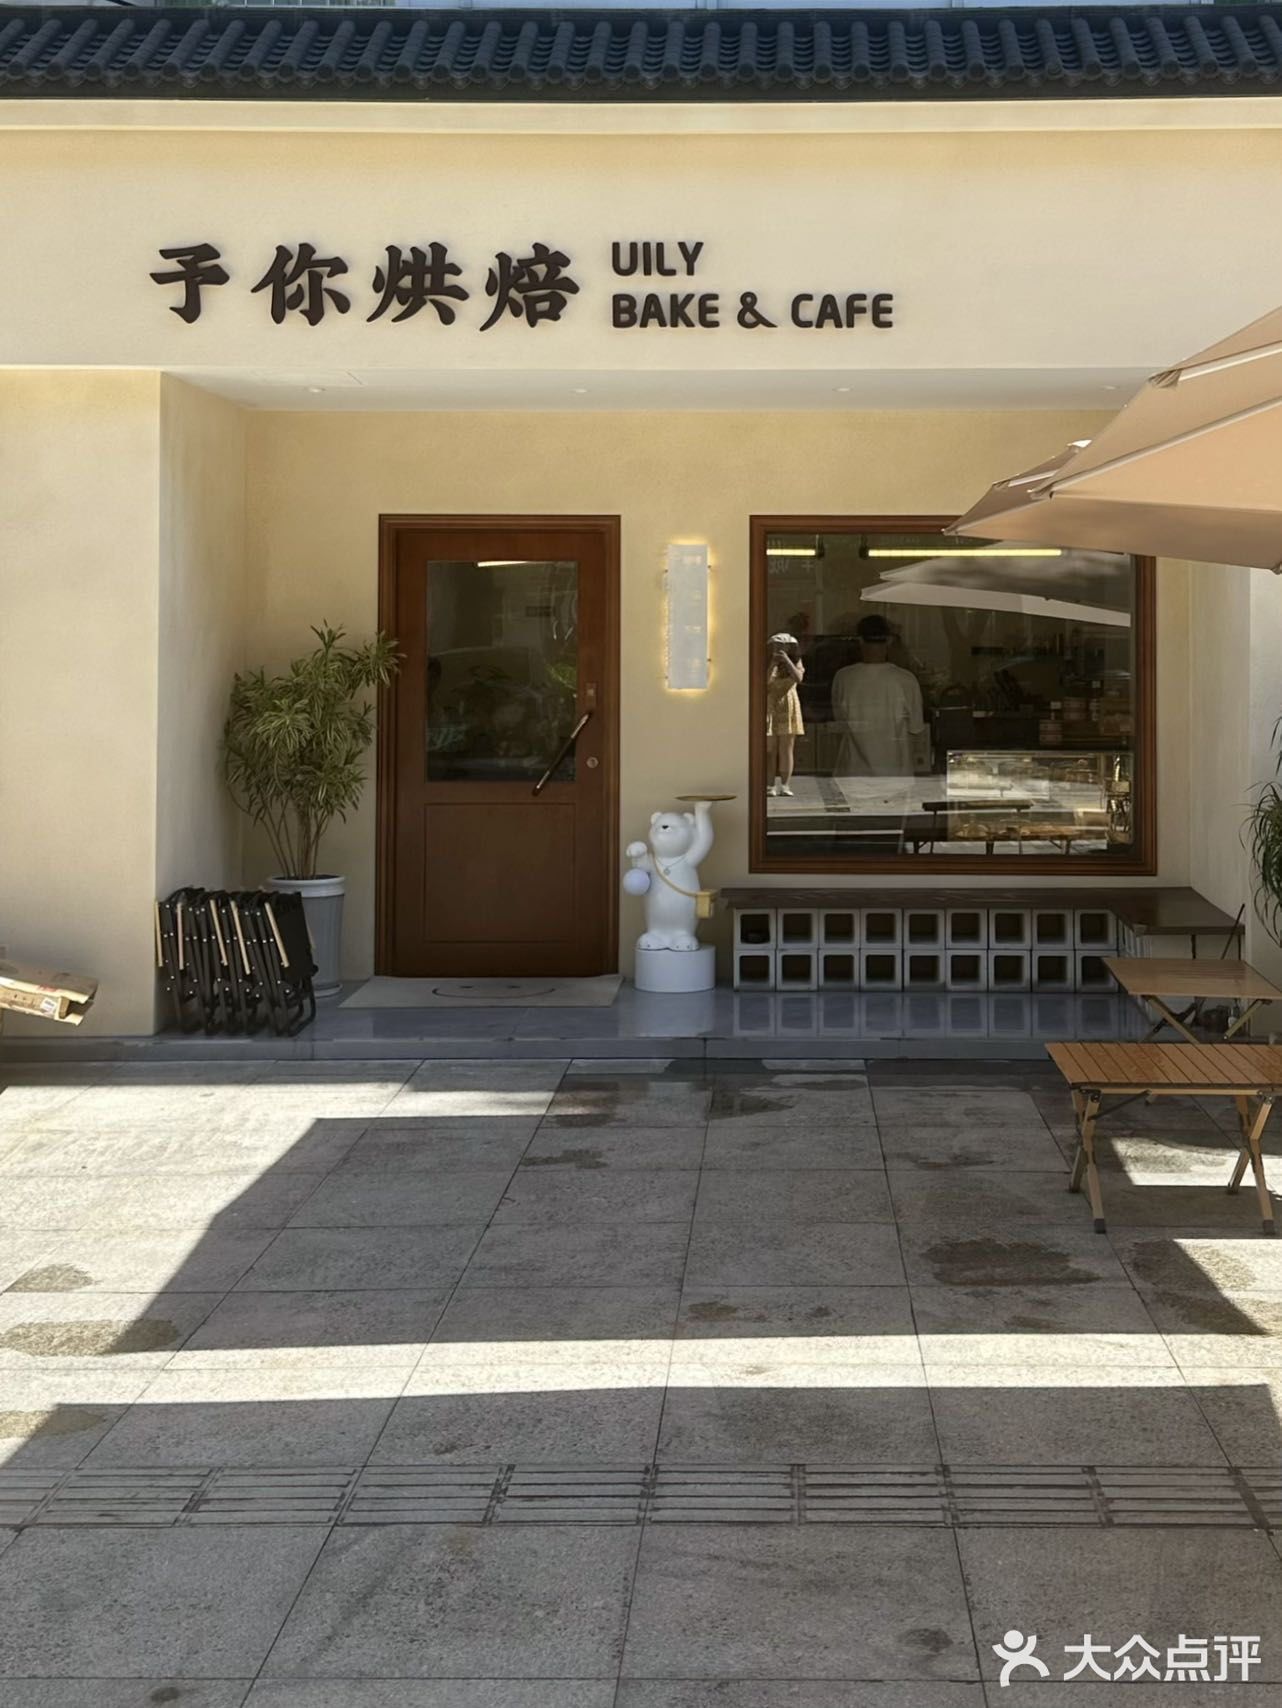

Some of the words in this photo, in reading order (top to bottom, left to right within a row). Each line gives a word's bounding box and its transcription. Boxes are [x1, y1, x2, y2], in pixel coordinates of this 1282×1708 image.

[612, 242, 703, 276] UILY
[150, 242, 579, 331] 予你烘焙
[613, 293, 720, 328] BAKE
[737, 292, 777, 329] &
[791, 293, 893, 328] CAFE
